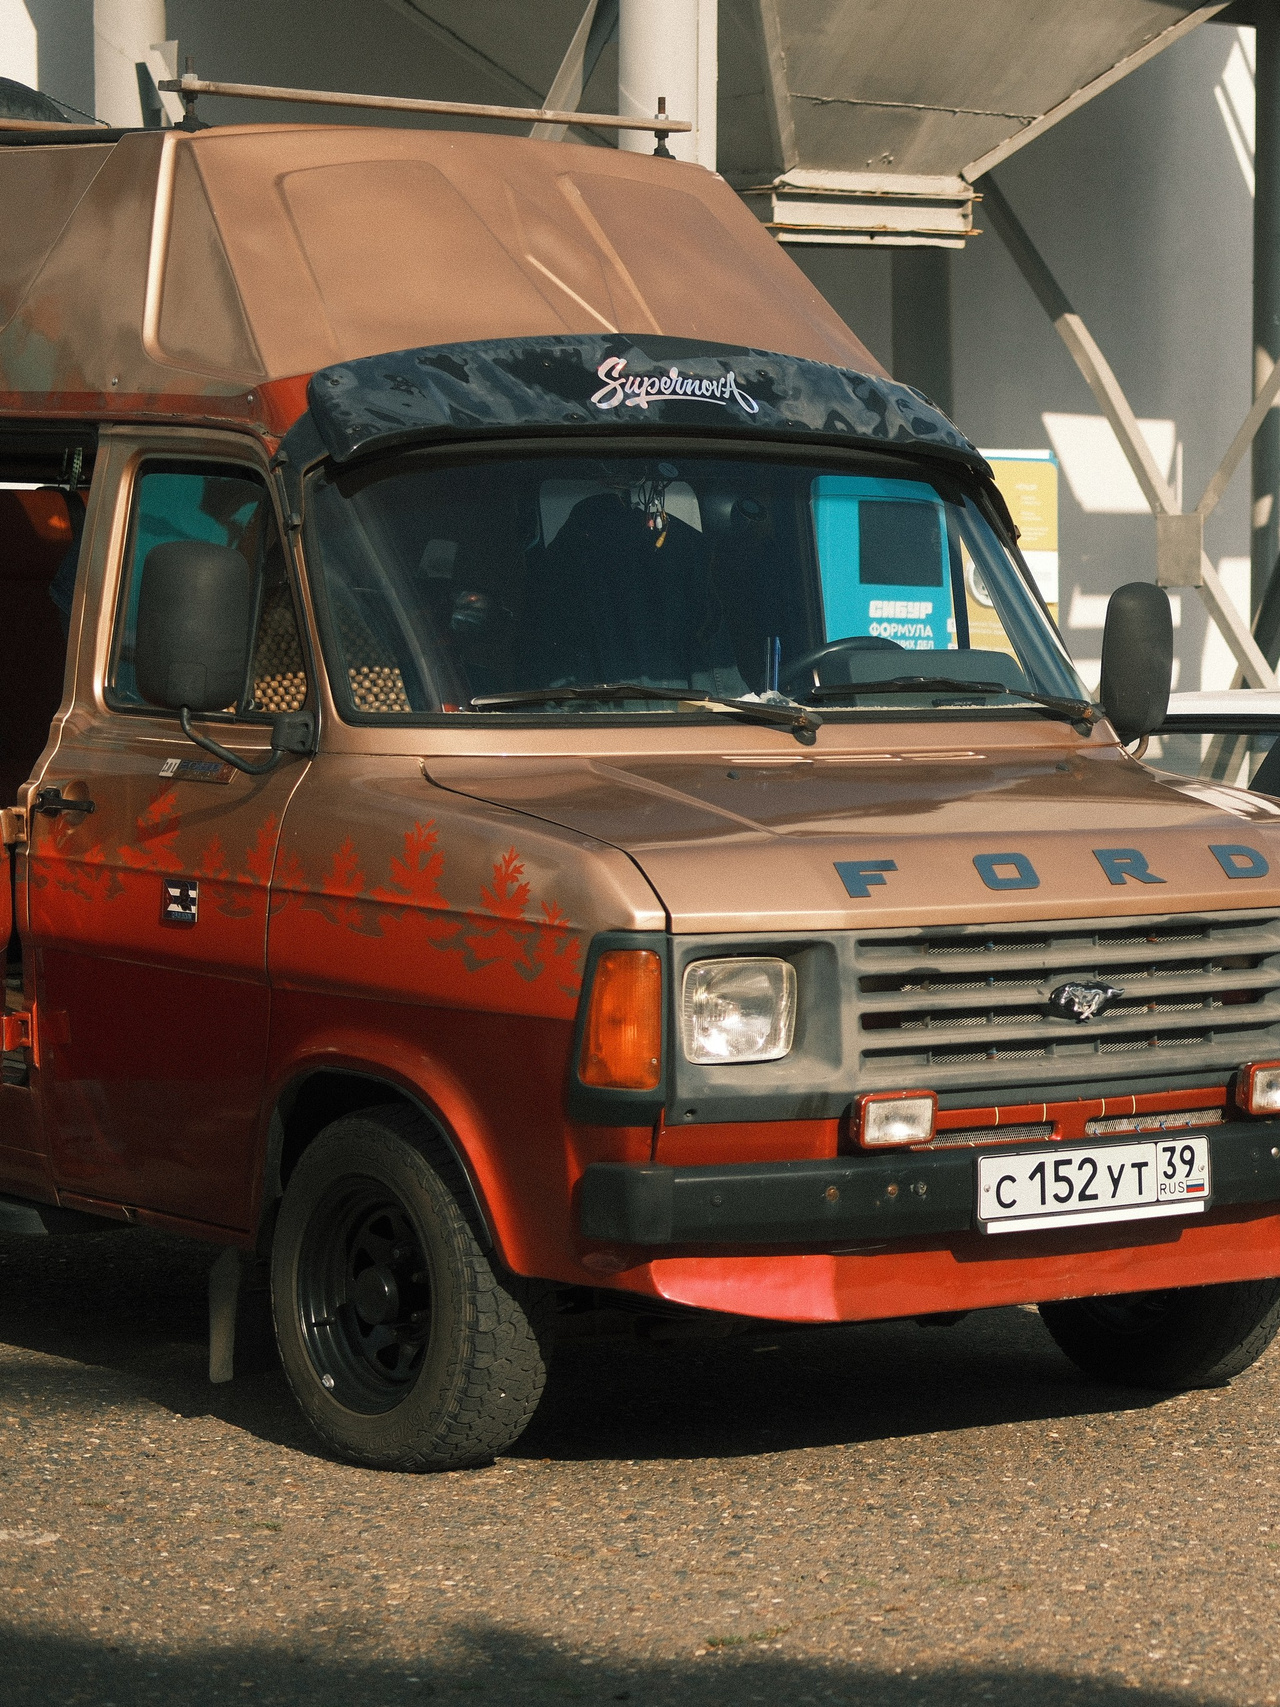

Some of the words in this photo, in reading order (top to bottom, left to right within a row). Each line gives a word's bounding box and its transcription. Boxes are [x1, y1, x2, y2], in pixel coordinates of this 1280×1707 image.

[869, 601, 933, 619] СИБУР
[869, 622, 933, 637] ФОРМУЛА
[833, 844, 1269, 898] FORD
[1162, 1145, 1195, 1180] 39
[1160, 1182, 1185, 1195] RUS
